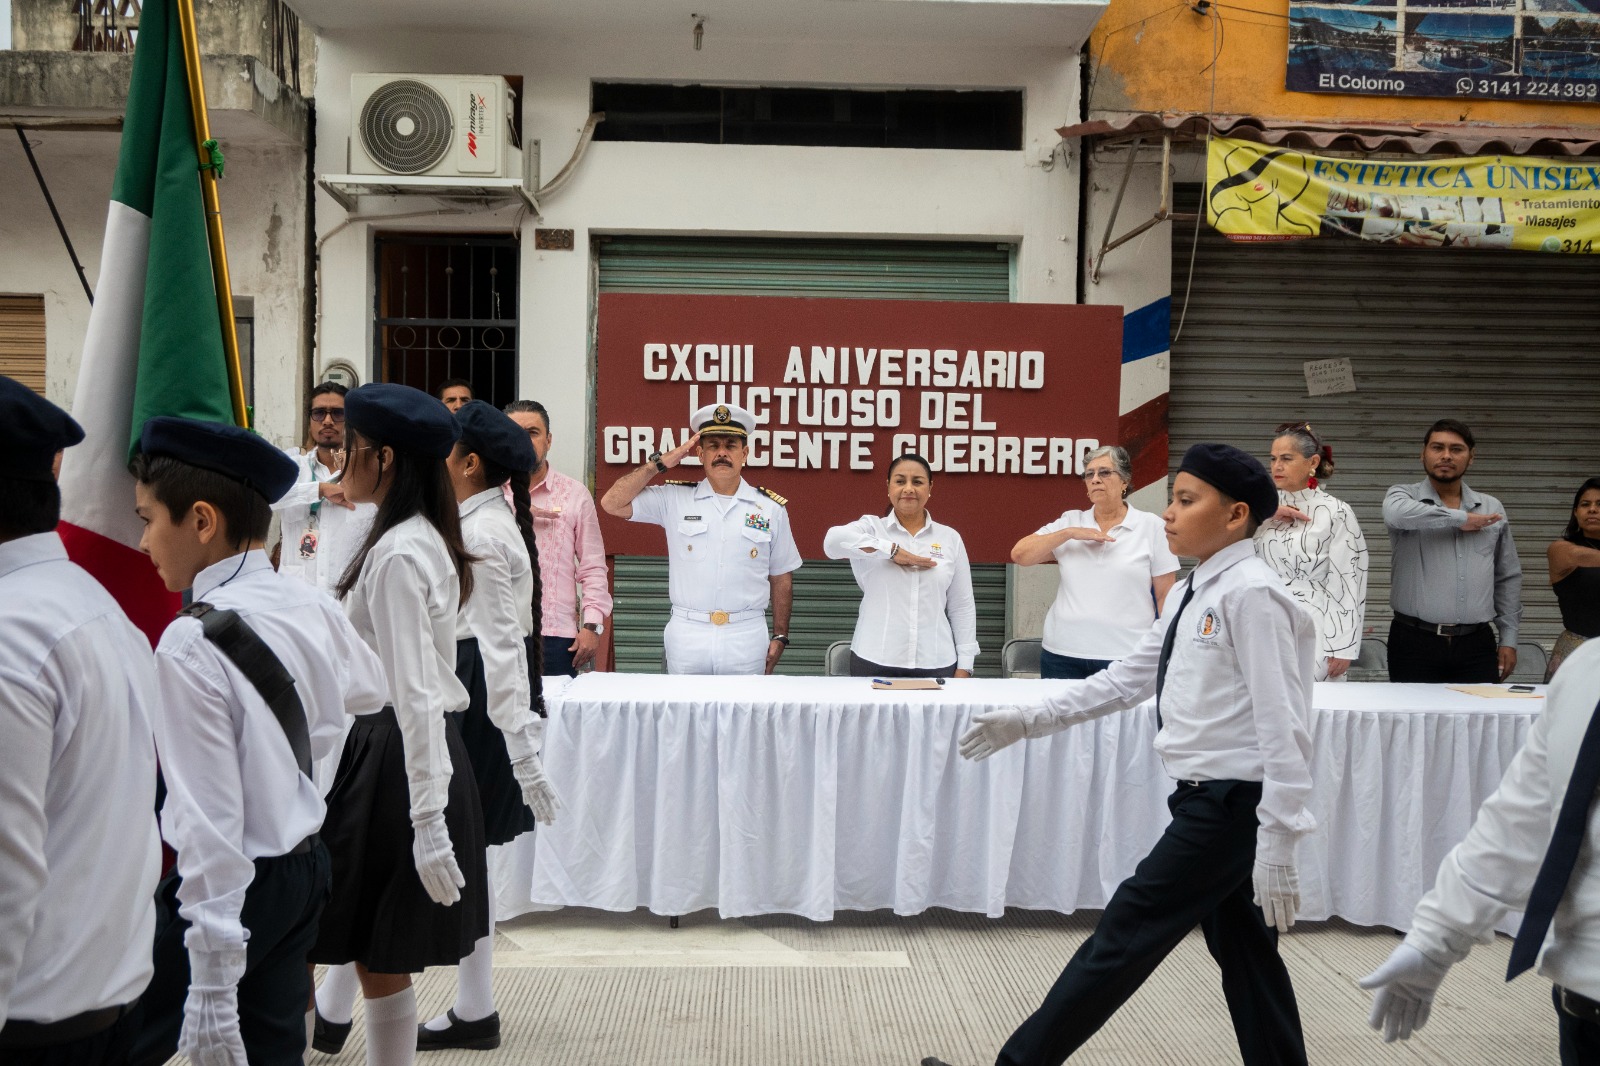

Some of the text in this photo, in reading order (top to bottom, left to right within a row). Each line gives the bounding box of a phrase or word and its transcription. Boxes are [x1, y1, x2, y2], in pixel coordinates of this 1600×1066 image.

[1319, 73, 1405, 91] El Colomo
[1478, 80, 1597, 97] 3141 224 393
[1484, 165, 1600, 190] UNISEX
[1526, 215, 1577, 230] Masajes
[1561, 239, 1593, 253] 314
[644, 343, 1045, 389] CXCIII ANIVERSARIO
[920, 391, 996, 431] DEL
[742, 430, 874, 470] CENTE
